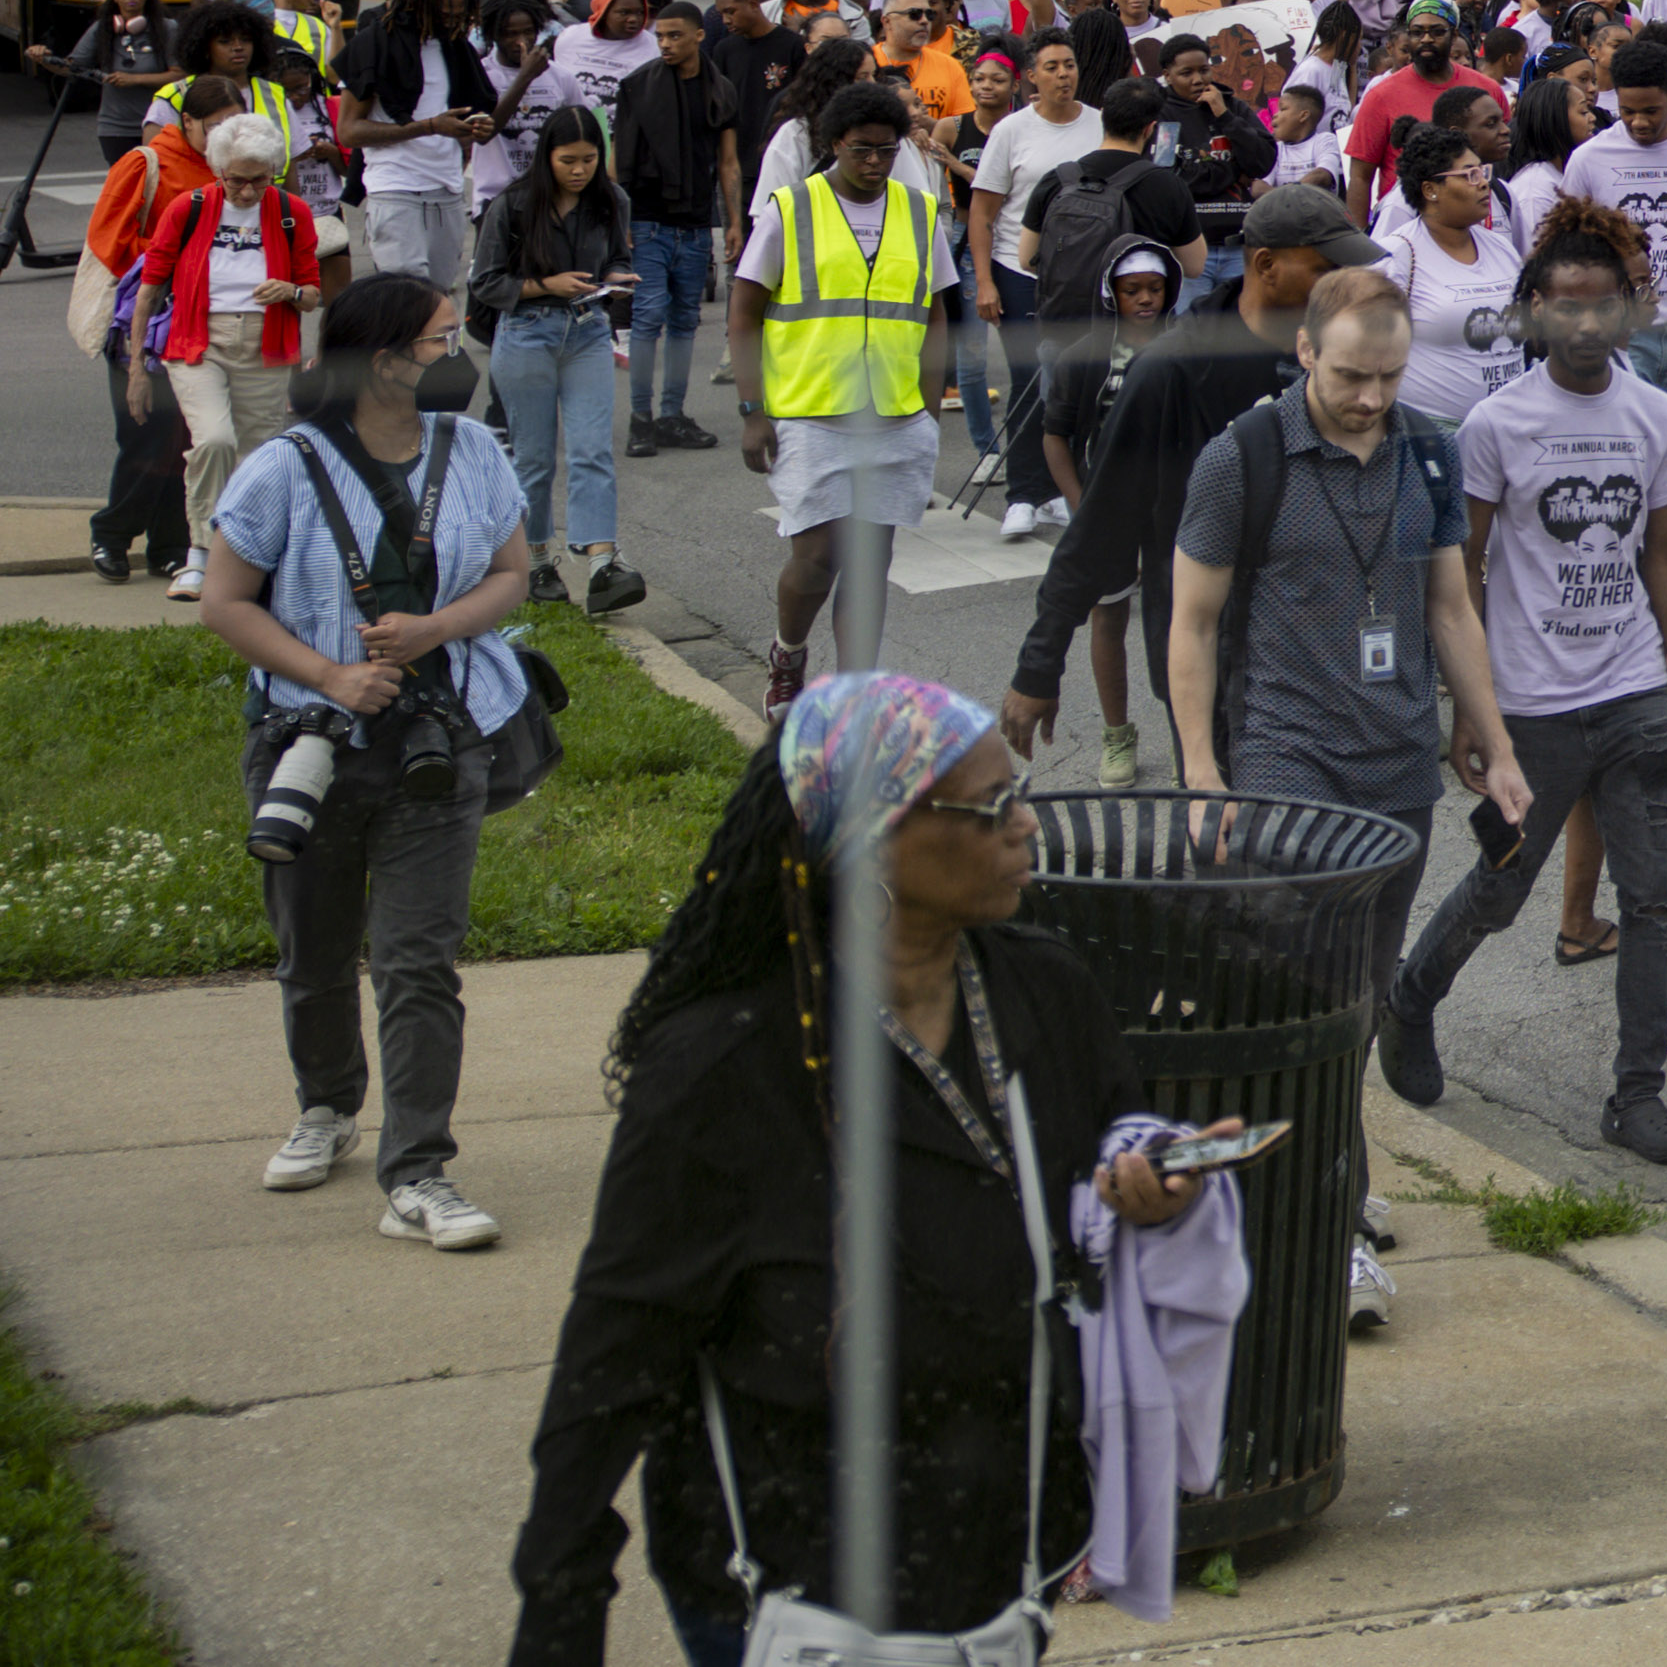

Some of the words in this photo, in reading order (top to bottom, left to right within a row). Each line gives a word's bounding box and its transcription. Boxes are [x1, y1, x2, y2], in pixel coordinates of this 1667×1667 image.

[508, 150, 523, 161] WE
[304, 174, 328, 184] WALK
[310, 186, 327, 194] HER
[1483, 365, 1501, 381] WE
[1551, 443, 1568, 455] 7TH
[1571, 442, 1607, 454] ANNUAL
[420, 485, 439, 533] SONY
[1557, 563, 1587, 585] WE
[1561, 586, 1596, 608] FOR
[1600, 583, 1634, 606] HER
[1540, 618, 1581, 638] Find
[1583, 624, 1612, 638] our
